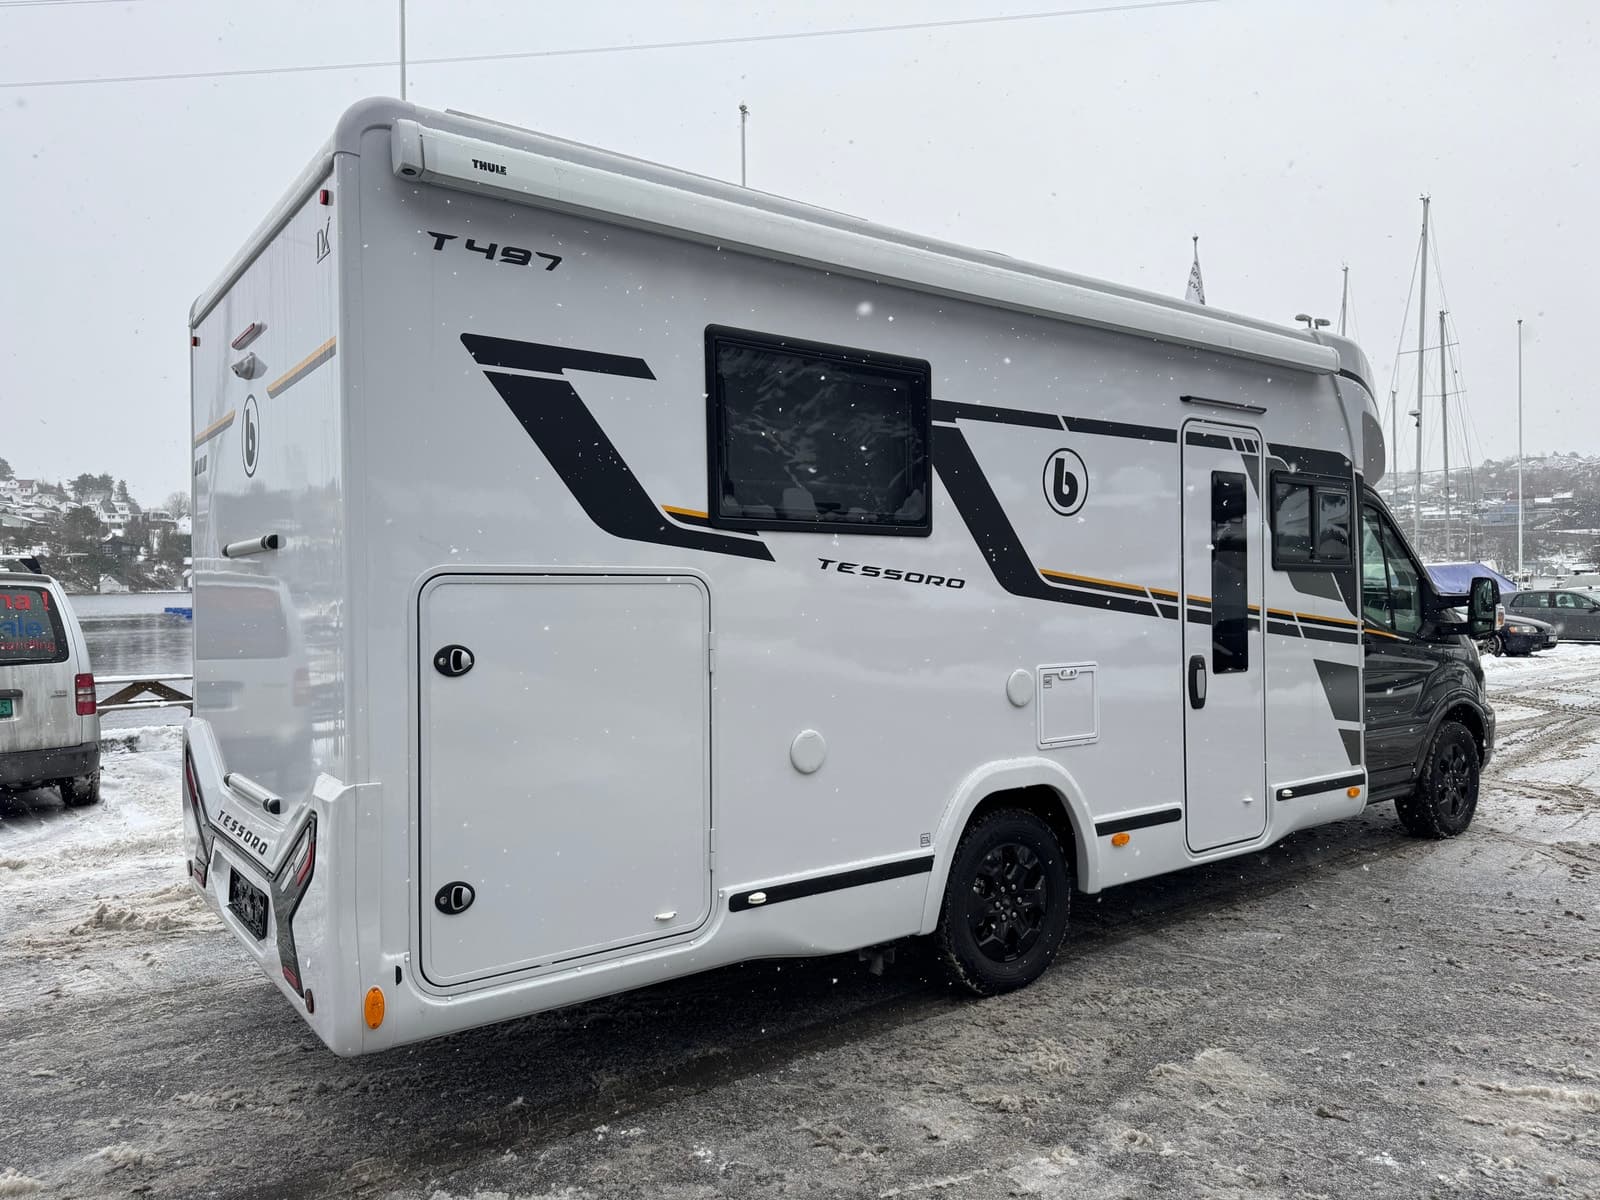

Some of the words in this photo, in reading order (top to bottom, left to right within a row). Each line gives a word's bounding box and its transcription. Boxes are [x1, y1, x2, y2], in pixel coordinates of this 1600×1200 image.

[472, 159, 507, 176] THULE
[465, 238, 563, 271] 497
[817, 558, 966, 590] TESSORO
[216, 810, 268, 857] TESSORO
